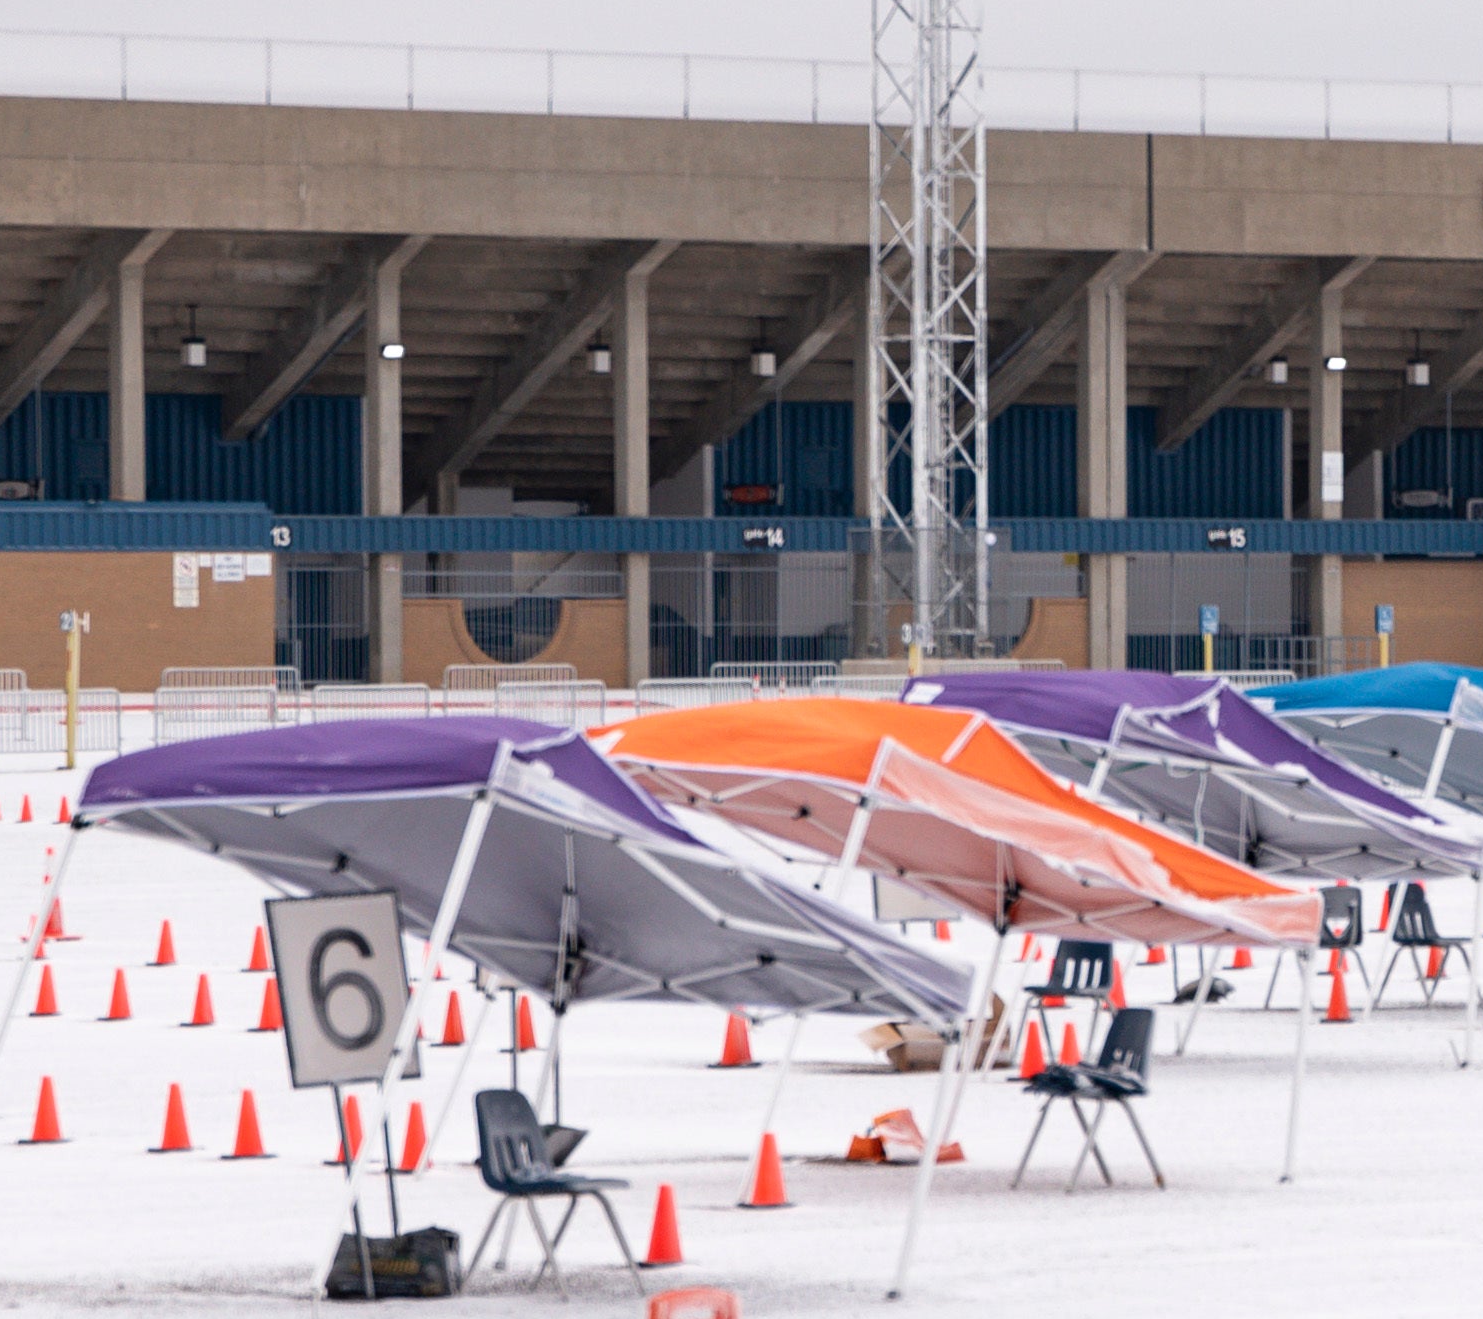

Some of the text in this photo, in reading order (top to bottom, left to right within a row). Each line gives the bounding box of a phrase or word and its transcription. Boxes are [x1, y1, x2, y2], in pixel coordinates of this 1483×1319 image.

[270, 526, 291, 547] 13
[766, 527, 785, 547] 14
[1228, 528, 1246, 548] 15
[309, 928, 385, 1050] 6
